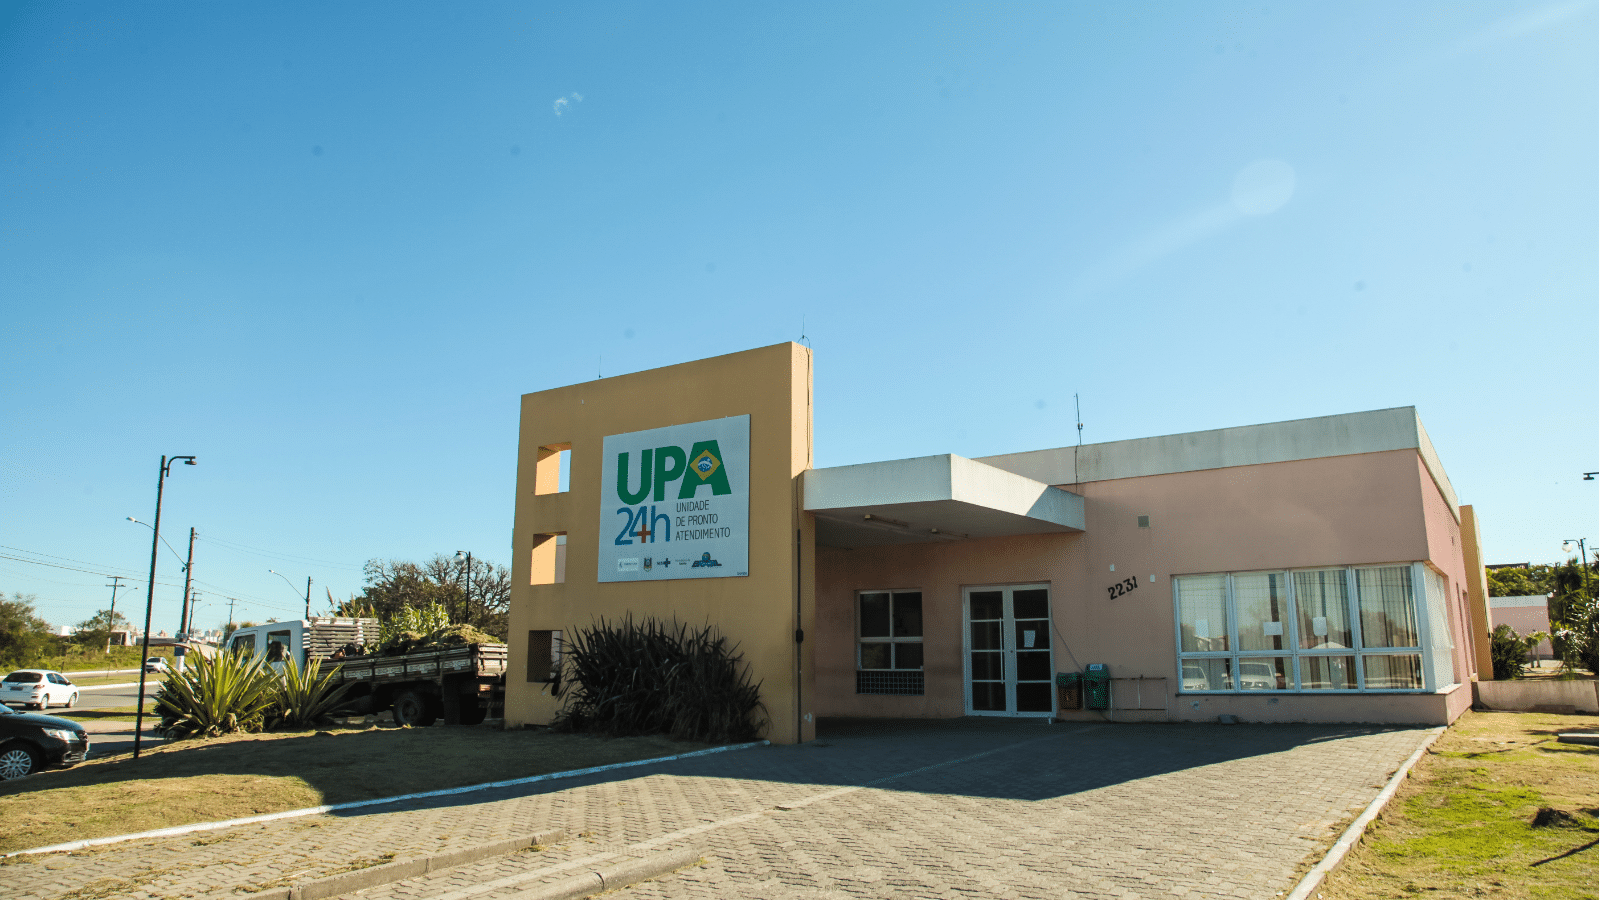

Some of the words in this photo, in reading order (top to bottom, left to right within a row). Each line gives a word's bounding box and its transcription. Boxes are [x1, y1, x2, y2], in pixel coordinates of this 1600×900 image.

[617, 440, 732, 505] UPA
[676, 500, 709, 512] UNIDADE
[615, 505, 670, 545] 24h
[676, 517, 685, 526] DE
[688, 514, 718, 526] PRONTO
[676, 527, 730, 541] ATENDIMENTO
[1107, 575, 1138, 600] 2231
